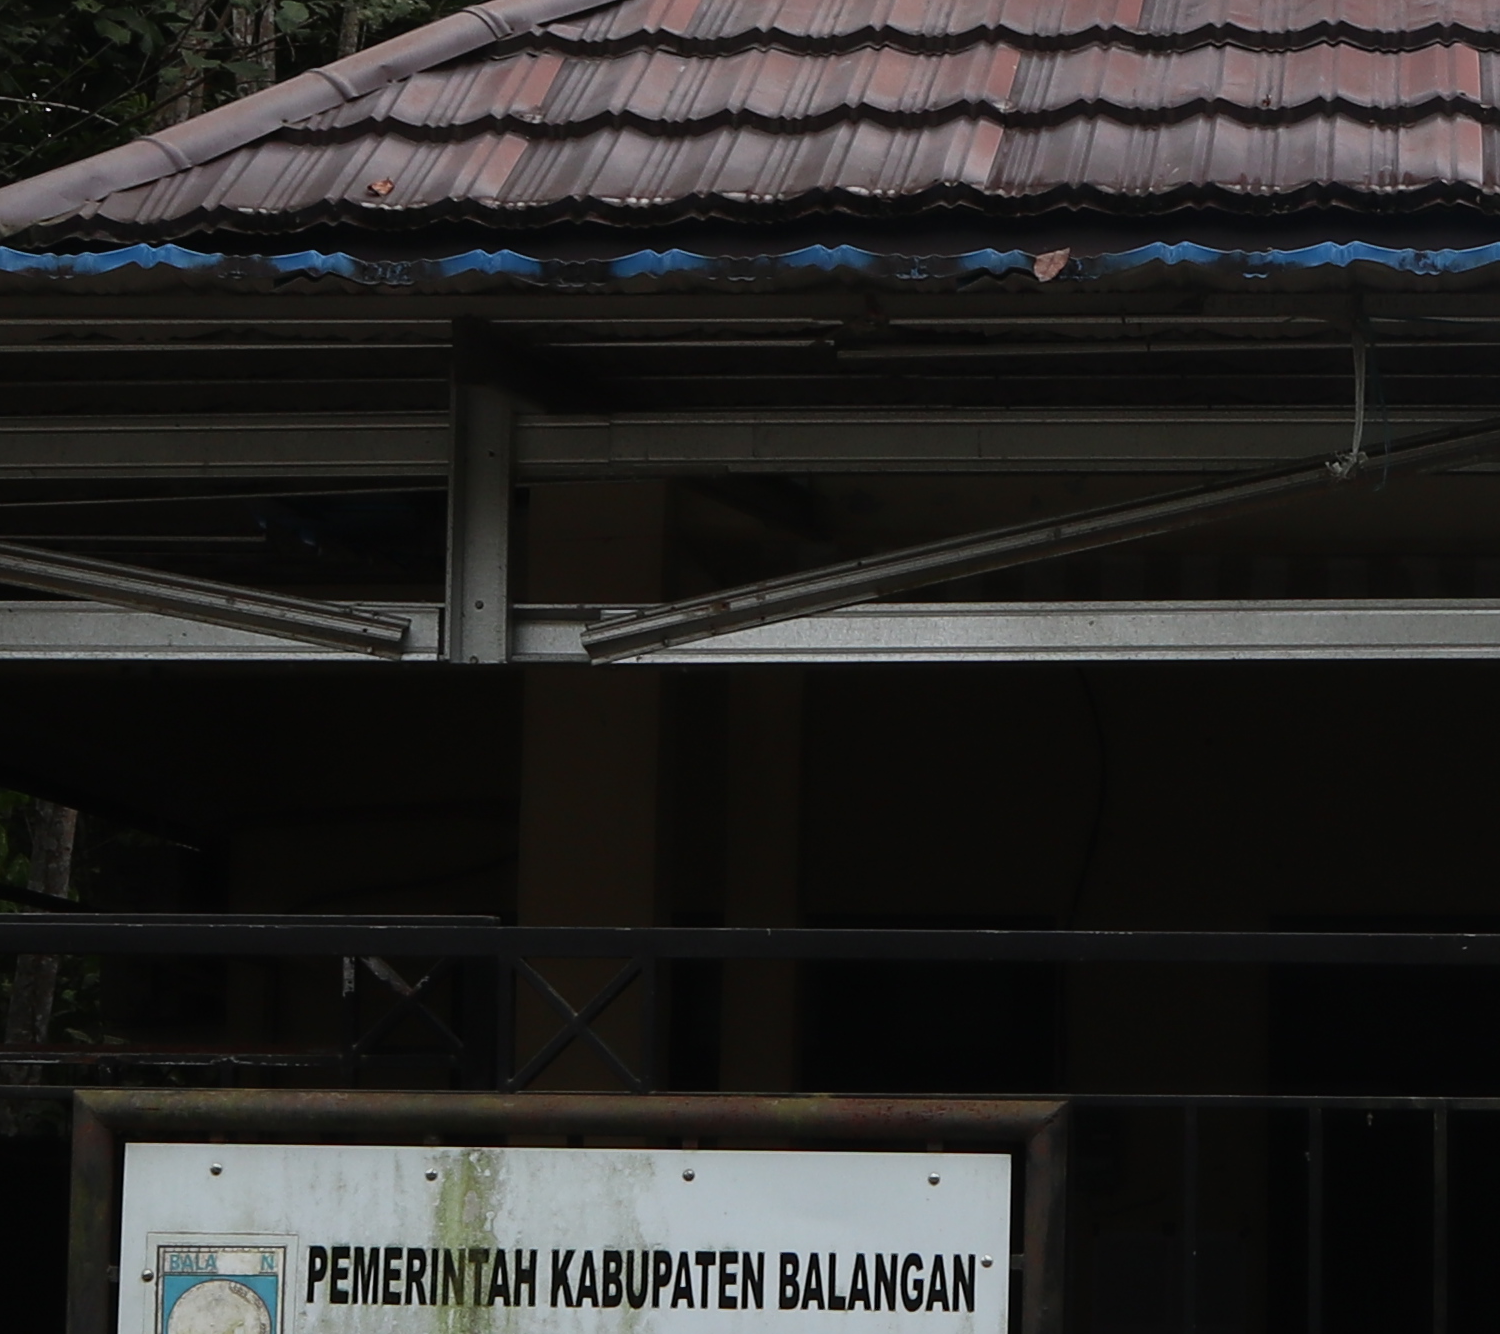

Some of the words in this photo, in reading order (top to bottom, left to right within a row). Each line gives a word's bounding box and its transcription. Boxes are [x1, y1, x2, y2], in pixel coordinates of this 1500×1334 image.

[169, 1253, 275, 1271] BALAN
[306, 1245, 538, 1309] PEMERINTAH
[550, 1249, 765, 1310] KABUPATEN
[778, 1252, 976, 1313] BALANGAN
